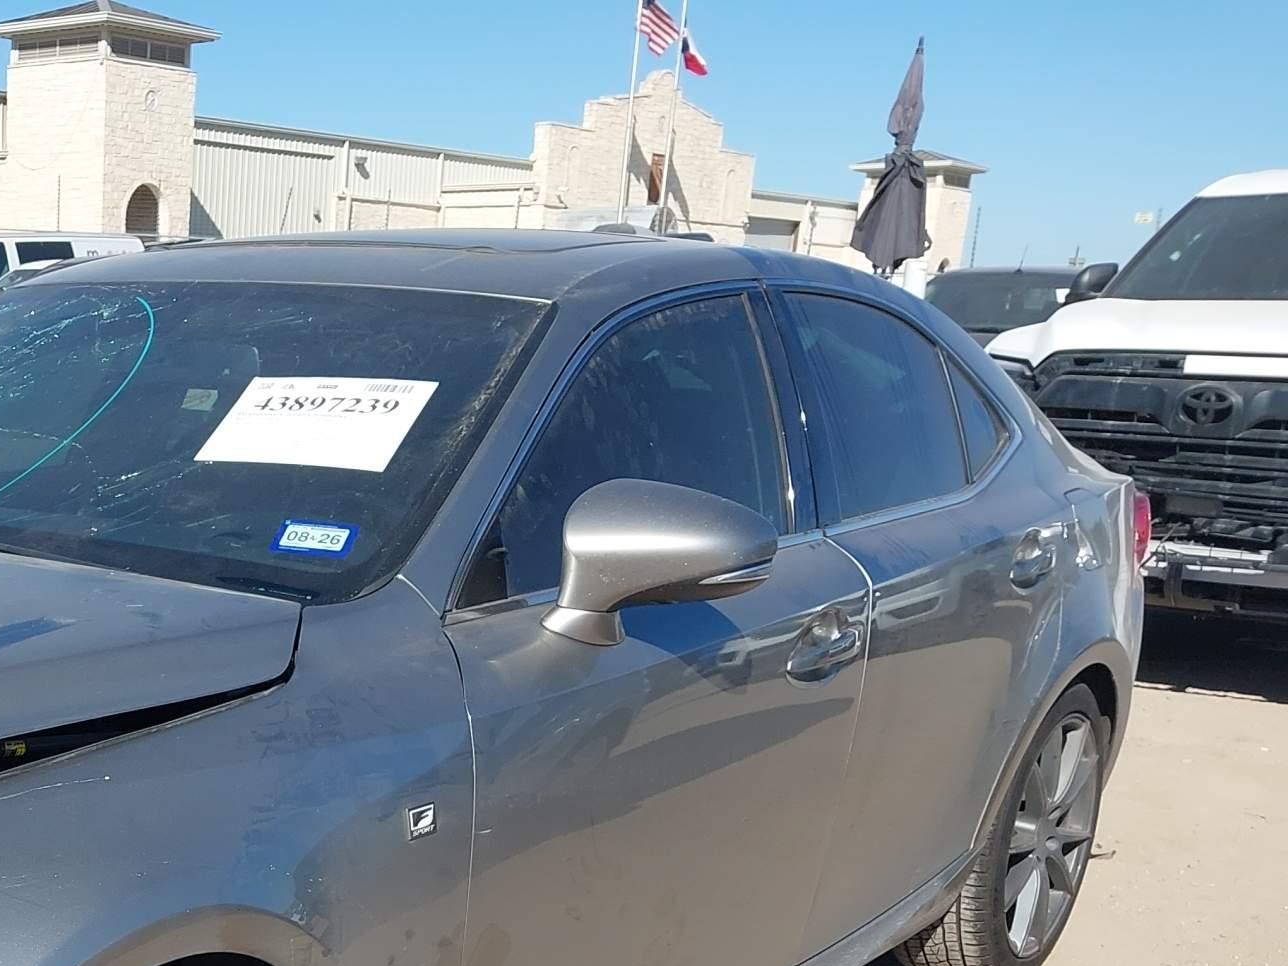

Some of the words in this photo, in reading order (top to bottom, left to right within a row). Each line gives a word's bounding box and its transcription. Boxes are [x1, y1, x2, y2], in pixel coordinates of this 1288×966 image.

[253, 395, 400, 414] 43897239
[286, 530, 310, 542] 08
[317, 533, 343, 545] 26
[412, 824, 435, 837] SPORT
